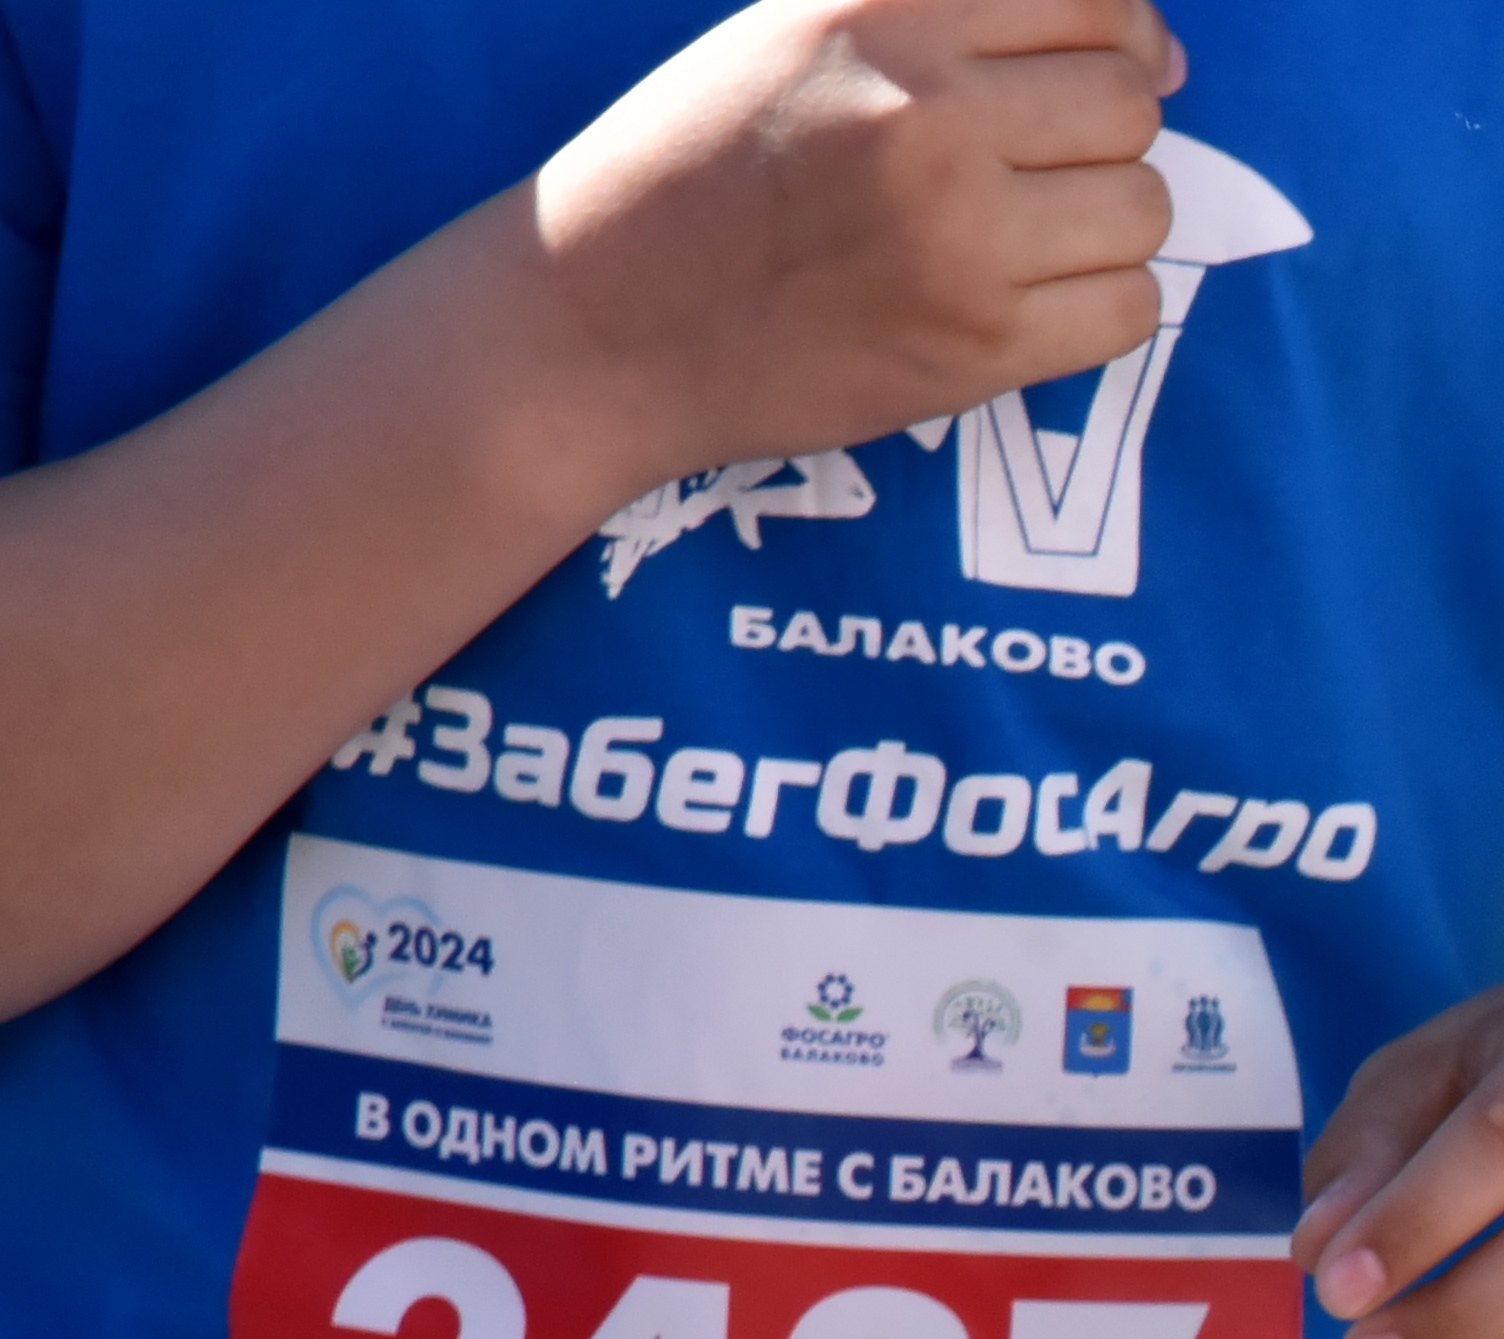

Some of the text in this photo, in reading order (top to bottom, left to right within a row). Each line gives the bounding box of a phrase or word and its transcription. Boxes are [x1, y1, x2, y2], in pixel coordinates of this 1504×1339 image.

[729, 605, 1147, 687] БАЛАКОВО
[388, 920, 495, 977] 2024
[781, 1026, 886, 1048] ФОСАГРО
[356, 1091, 1216, 1212] В ОДНОМ РИТМЕ С БАЛАКОВО
